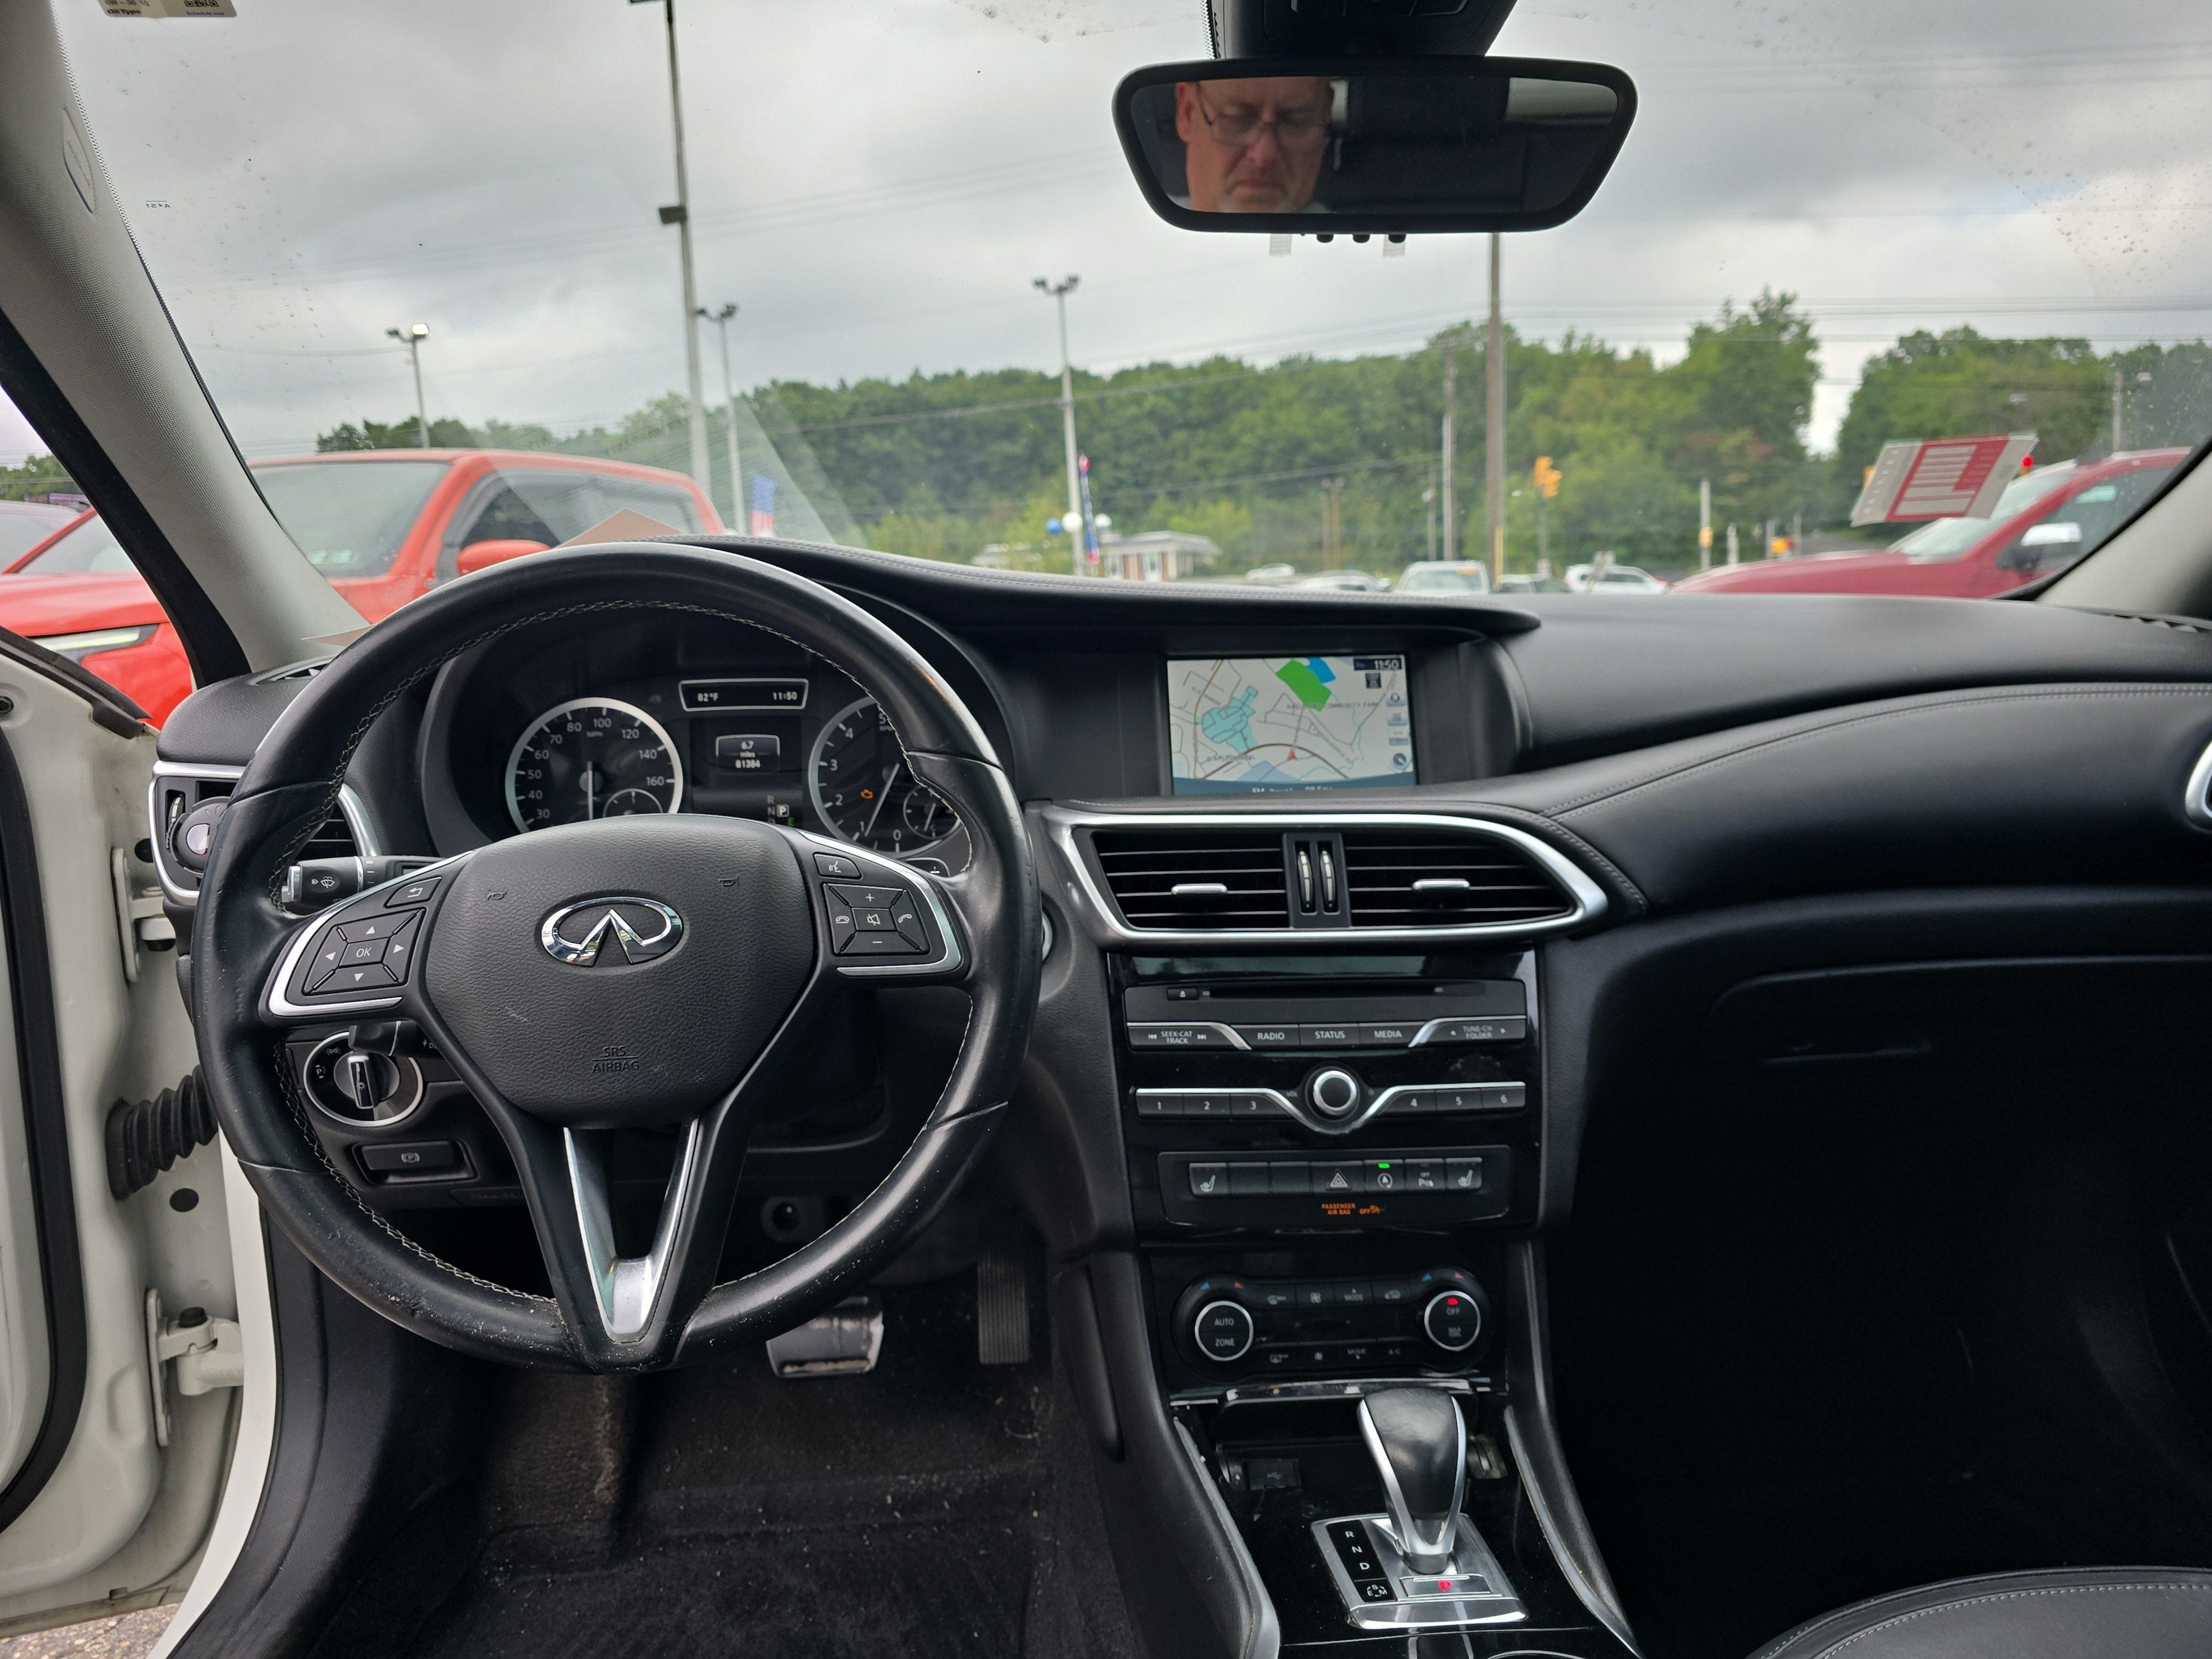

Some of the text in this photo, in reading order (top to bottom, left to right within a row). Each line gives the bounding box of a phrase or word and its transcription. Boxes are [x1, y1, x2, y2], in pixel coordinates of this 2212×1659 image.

[773, 691, 798, 700] 11:50
[567, 722, 582, 732] 80
[593, 718, 612, 728] 100
[622, 729, 639, 739] 120
[845, 728, 853, 738] 4
[550, 735, 562, 744] 70
[534, 749, 549, 759] 60
[639, 749, 657, 759] 140
[830, 759, 838, 771] 3
[528, 769, 542, 779] 50
[646, 776, 664, 786] 160
[528, 790, 543, 799] 40
[767, 795, 775, 804] R
[835, 794, 843, 806] 2
[536, 809, 550, 819] 30
[767, 807, 775, 815] N
[860, 821, 865, 832] 1
[893, 829, 902, 840] 0
[356, 946, 372, 958] OK
[1257, 1032, 1285, 1040] RADIO
[1315, 1031, 1346, 1039] STATUS
[1374, 1030, 1403, 1039] MEDIA
[603, 1046, 627, 1057] SRS
[591, 1061, 640, 1073] AIRBAG
[1411, 1098, 1418, 1107] 4
[1456, 1096, 1462, 1106] 5
[1501, 1094, 1508, 1104] 6
[1157, 1102, 1161, 1110] 1
[1204, 1102, 1210, 1110] 2
[1250, 1101, 1257, 1110] 3
[1214, 1318, 1234, 1326] AUTO
[1215, 1338, 1235, 1347] ZONE
[1345, 1531, 1355, 1539] R
[1359, 1562, 1370, 1570] D
[1438, 1580, 1452, 1592] P
